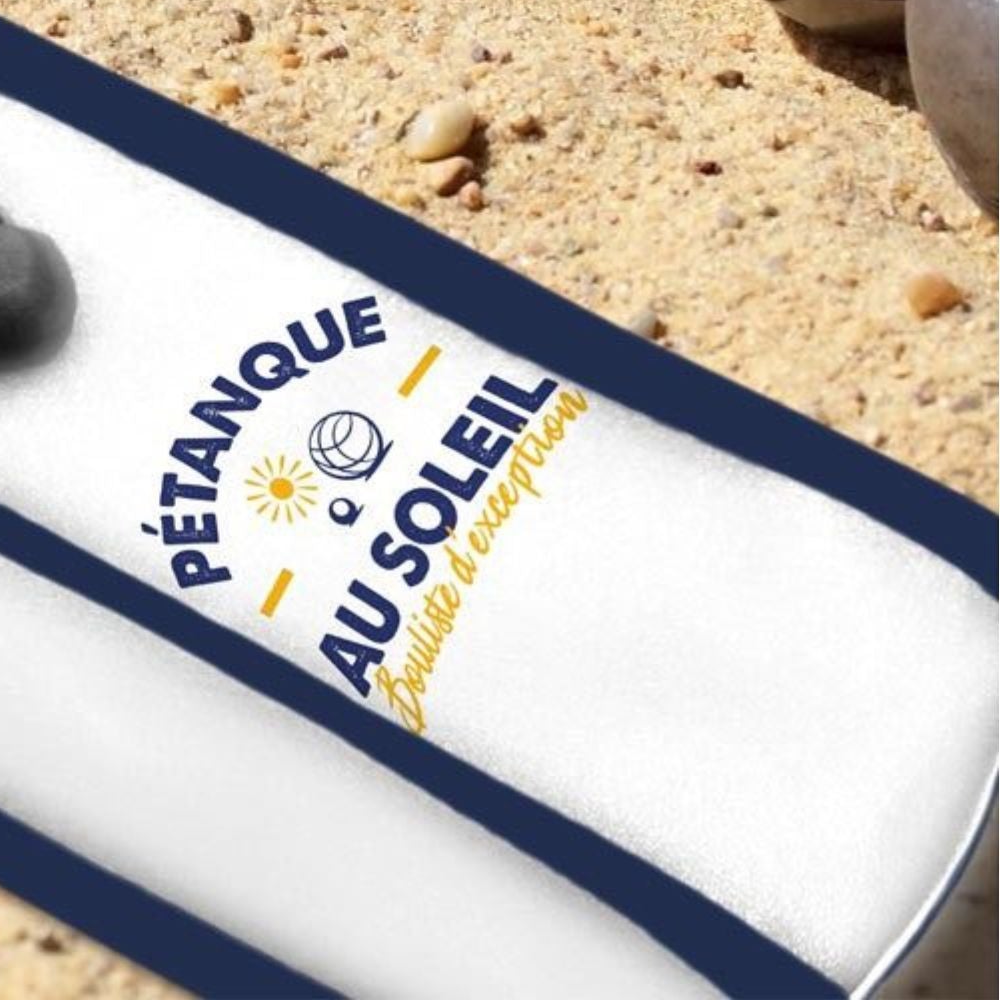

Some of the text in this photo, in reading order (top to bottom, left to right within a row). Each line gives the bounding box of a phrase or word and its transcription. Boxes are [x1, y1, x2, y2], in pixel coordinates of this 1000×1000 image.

[141, 296, 386, 588] PÉTANQUE
[319, 375, 558, 697] AU SOLEIL
[374, 389, 588, 734] Bouliste d'exception
